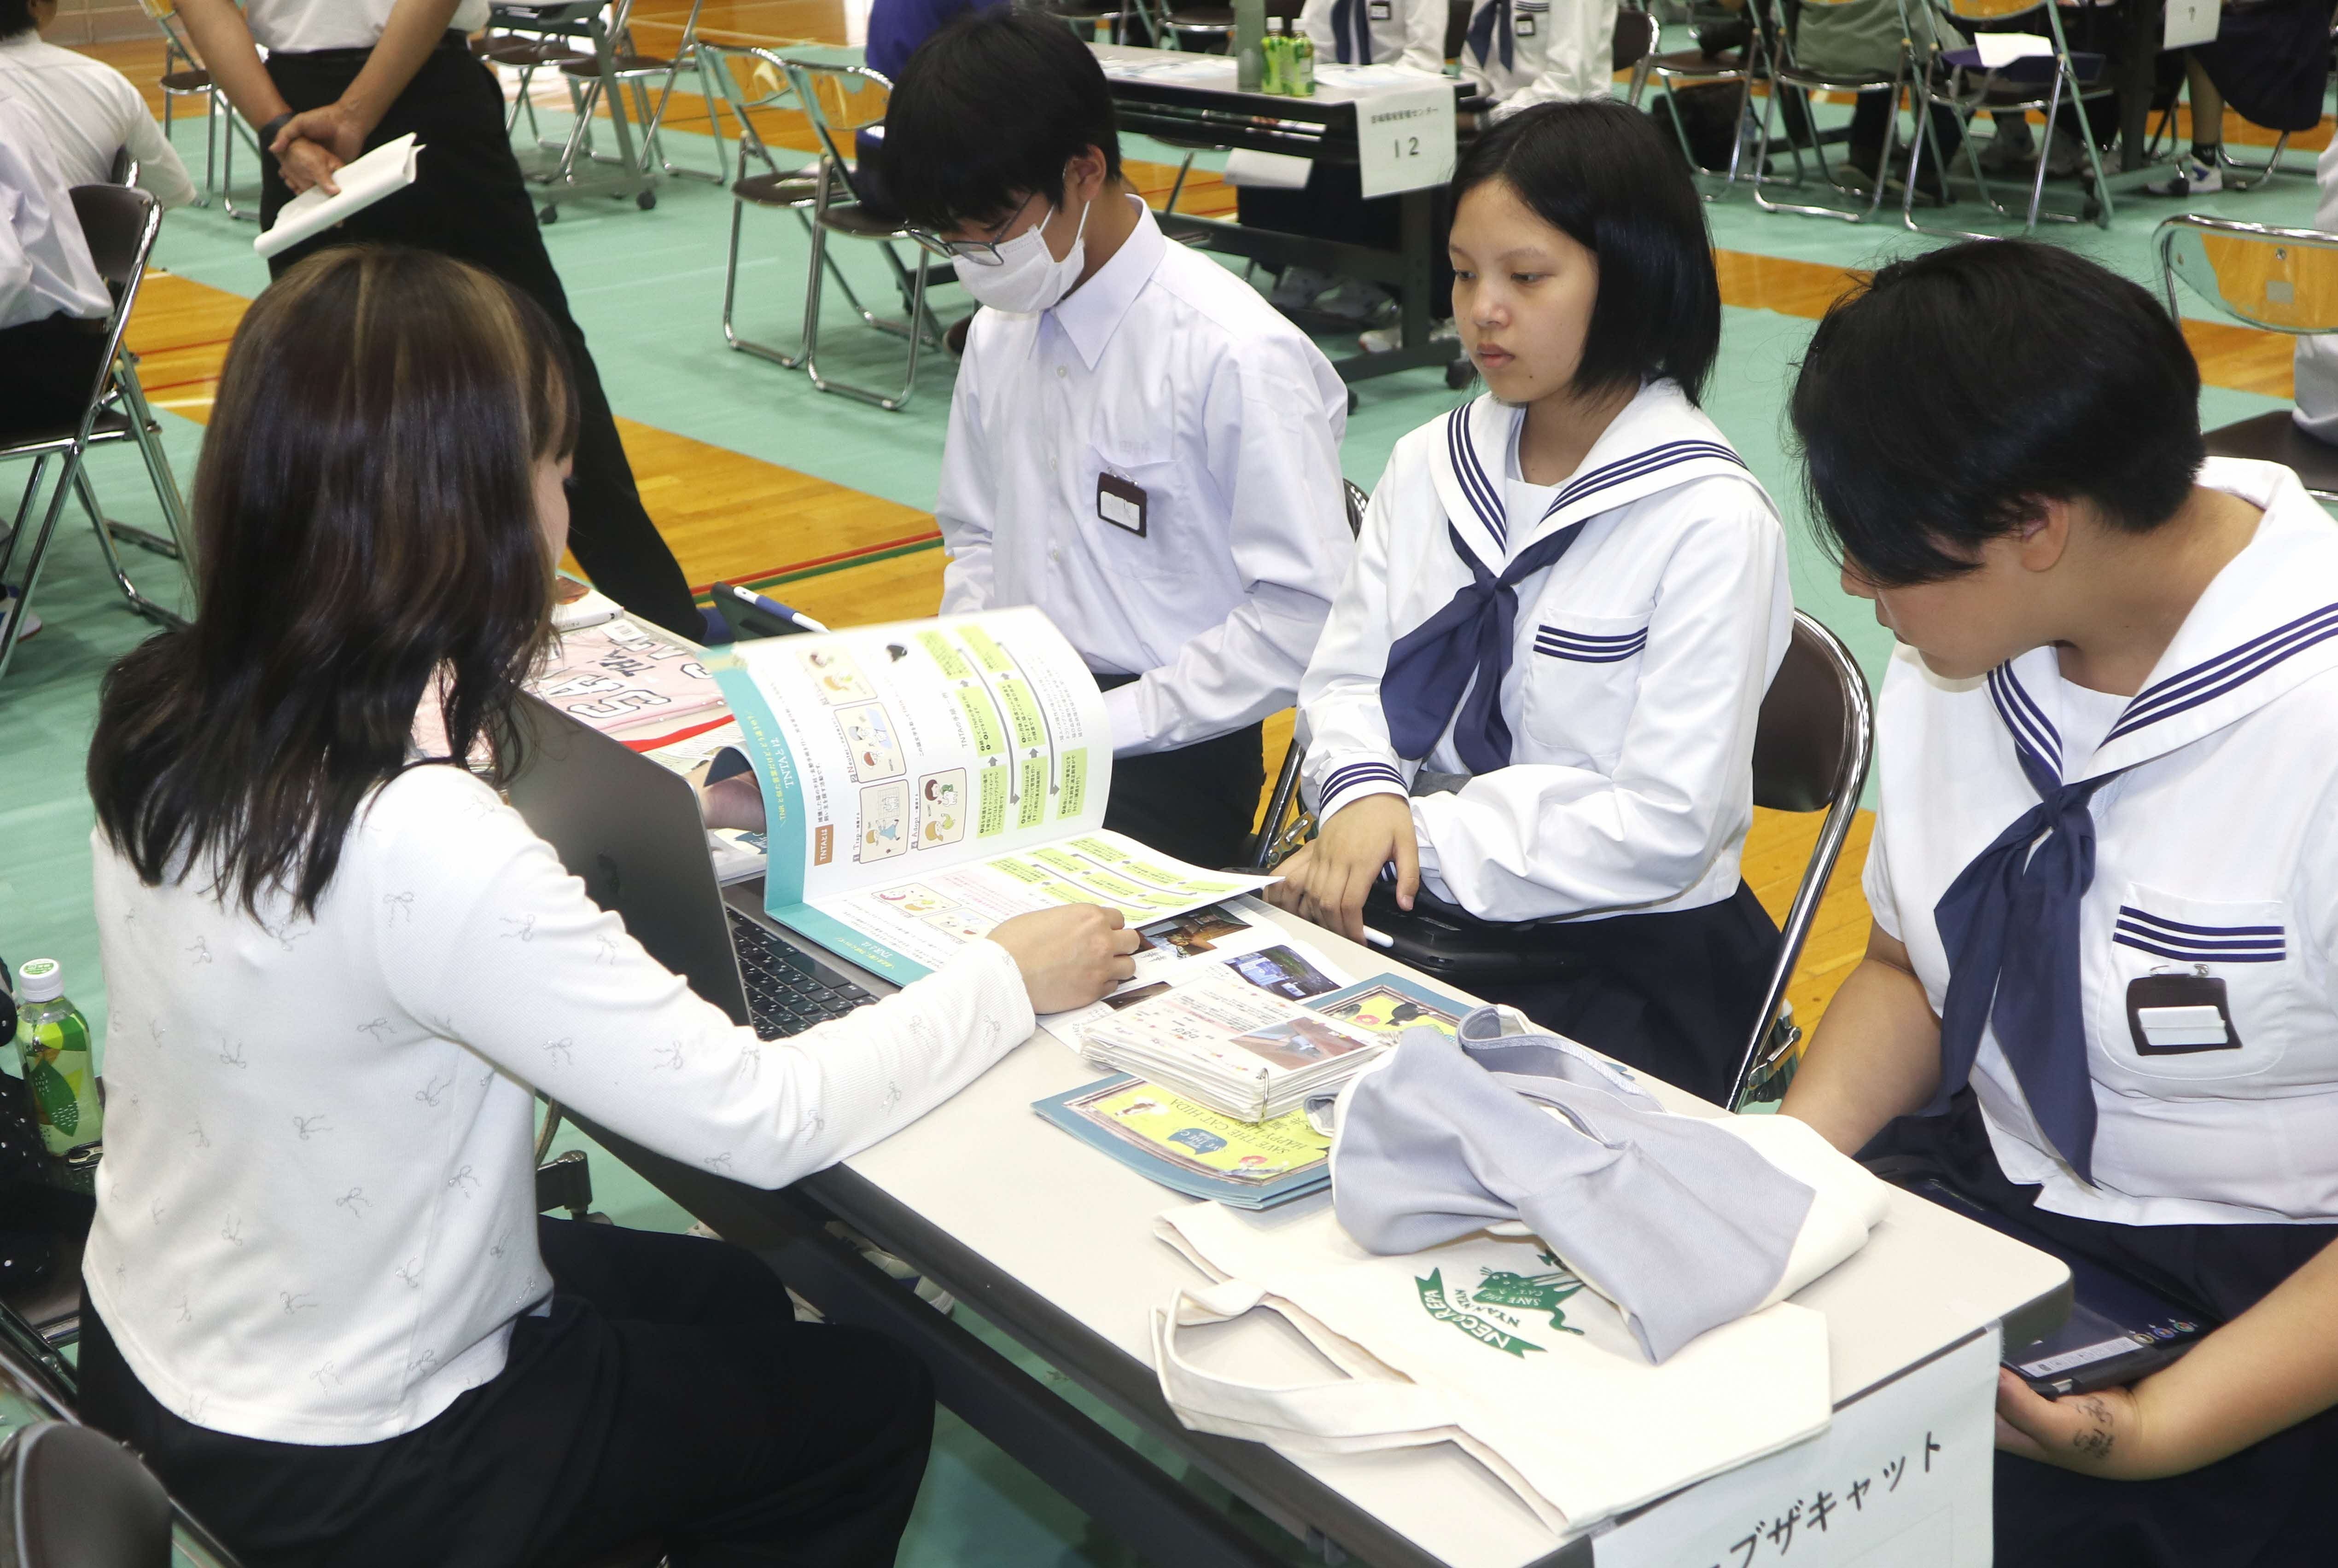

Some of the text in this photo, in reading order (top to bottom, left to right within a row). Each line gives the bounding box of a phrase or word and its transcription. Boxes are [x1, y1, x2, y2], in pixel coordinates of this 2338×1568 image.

[770, 737, 794, 788] TNTAとは
[845, 749, 854, 772] Neuter
[1072, 1023, 1083, 1038] SPACE
[1168, 1098, 1289, 1156] SAVE THE CAT HIDA
[1263, 1132, 1307, 1149] HAPPY
[1507, 1297, 1541, 1306] SAVE
[1710, 1431, 1940, 1568] ブザキャット
